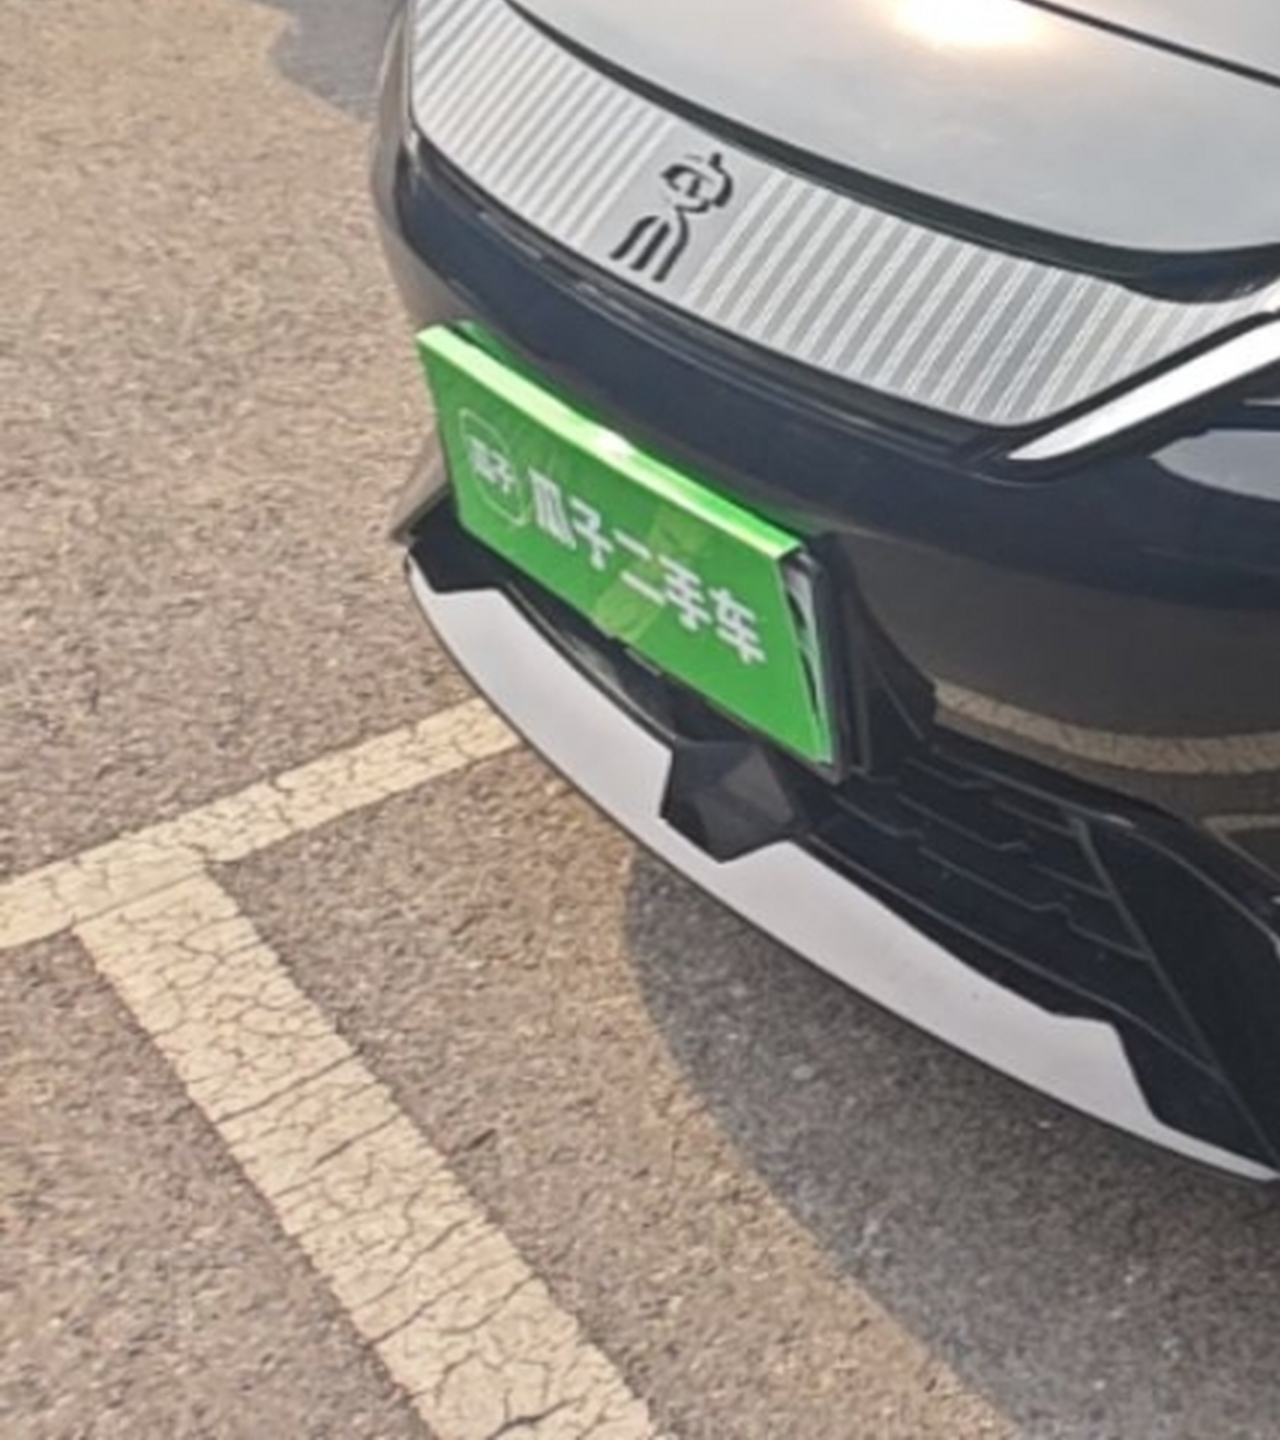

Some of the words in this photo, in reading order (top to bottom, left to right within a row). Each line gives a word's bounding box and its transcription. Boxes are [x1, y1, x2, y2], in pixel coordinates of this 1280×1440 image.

[528, 467, 766, 664] 瓜子二手车
